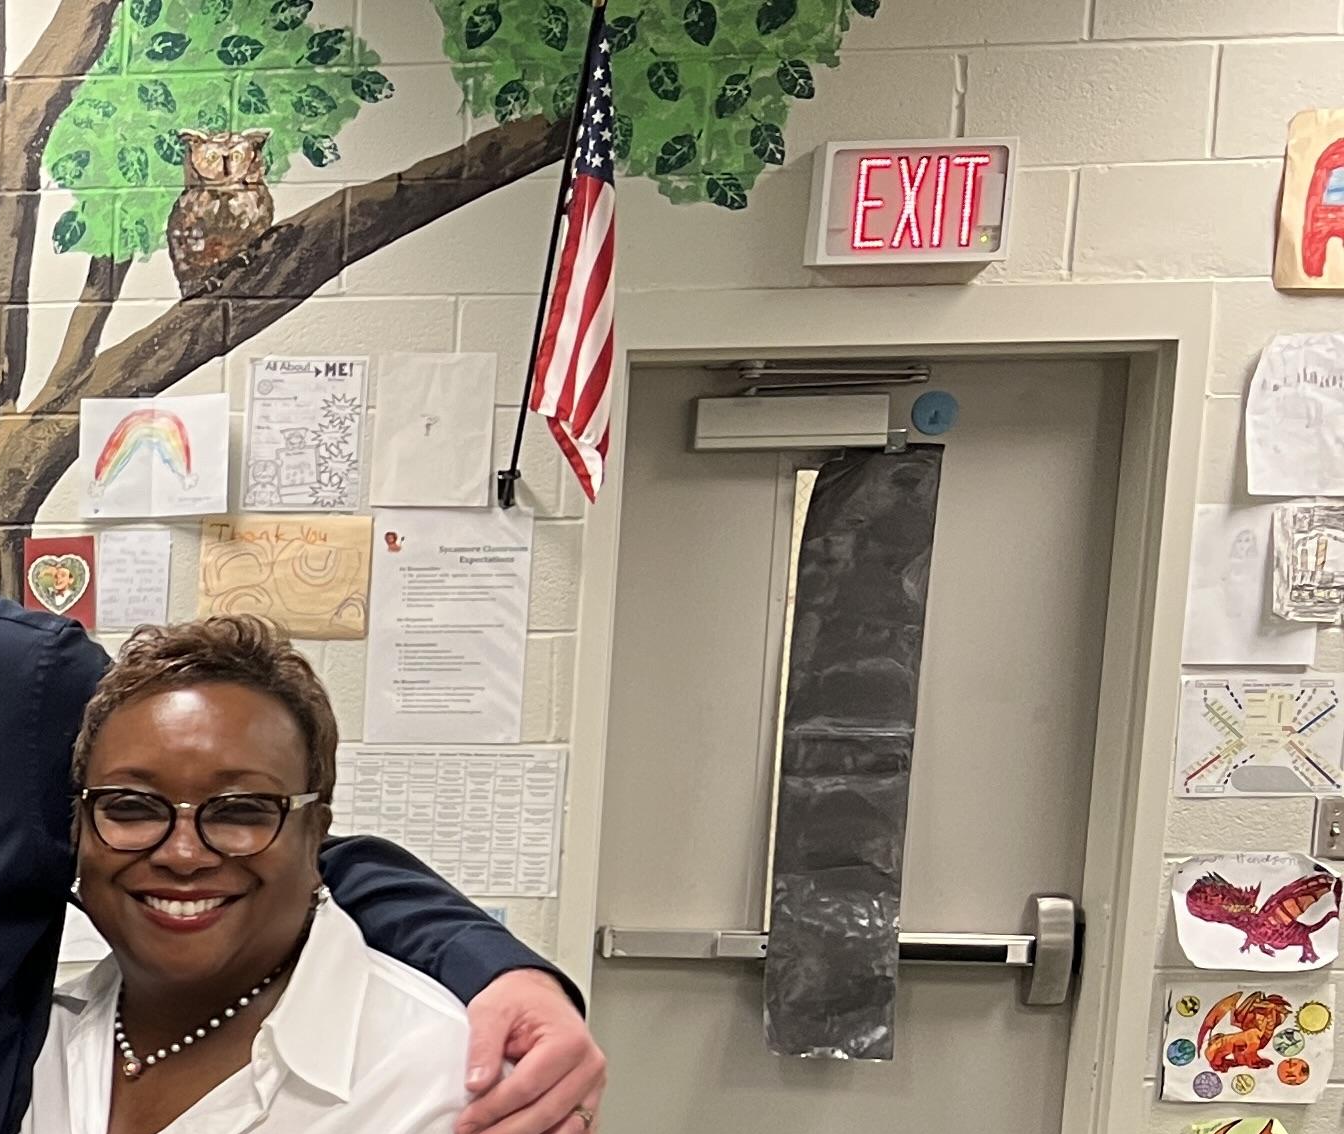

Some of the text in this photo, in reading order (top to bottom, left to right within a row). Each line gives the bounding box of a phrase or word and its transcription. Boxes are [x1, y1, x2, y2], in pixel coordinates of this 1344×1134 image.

[851, 153, 991, 250] EXIT
[280, 361, 311, 372] About
[323, 362, 354, 377] ME!
[210, 522, 327, 545] Thank You
